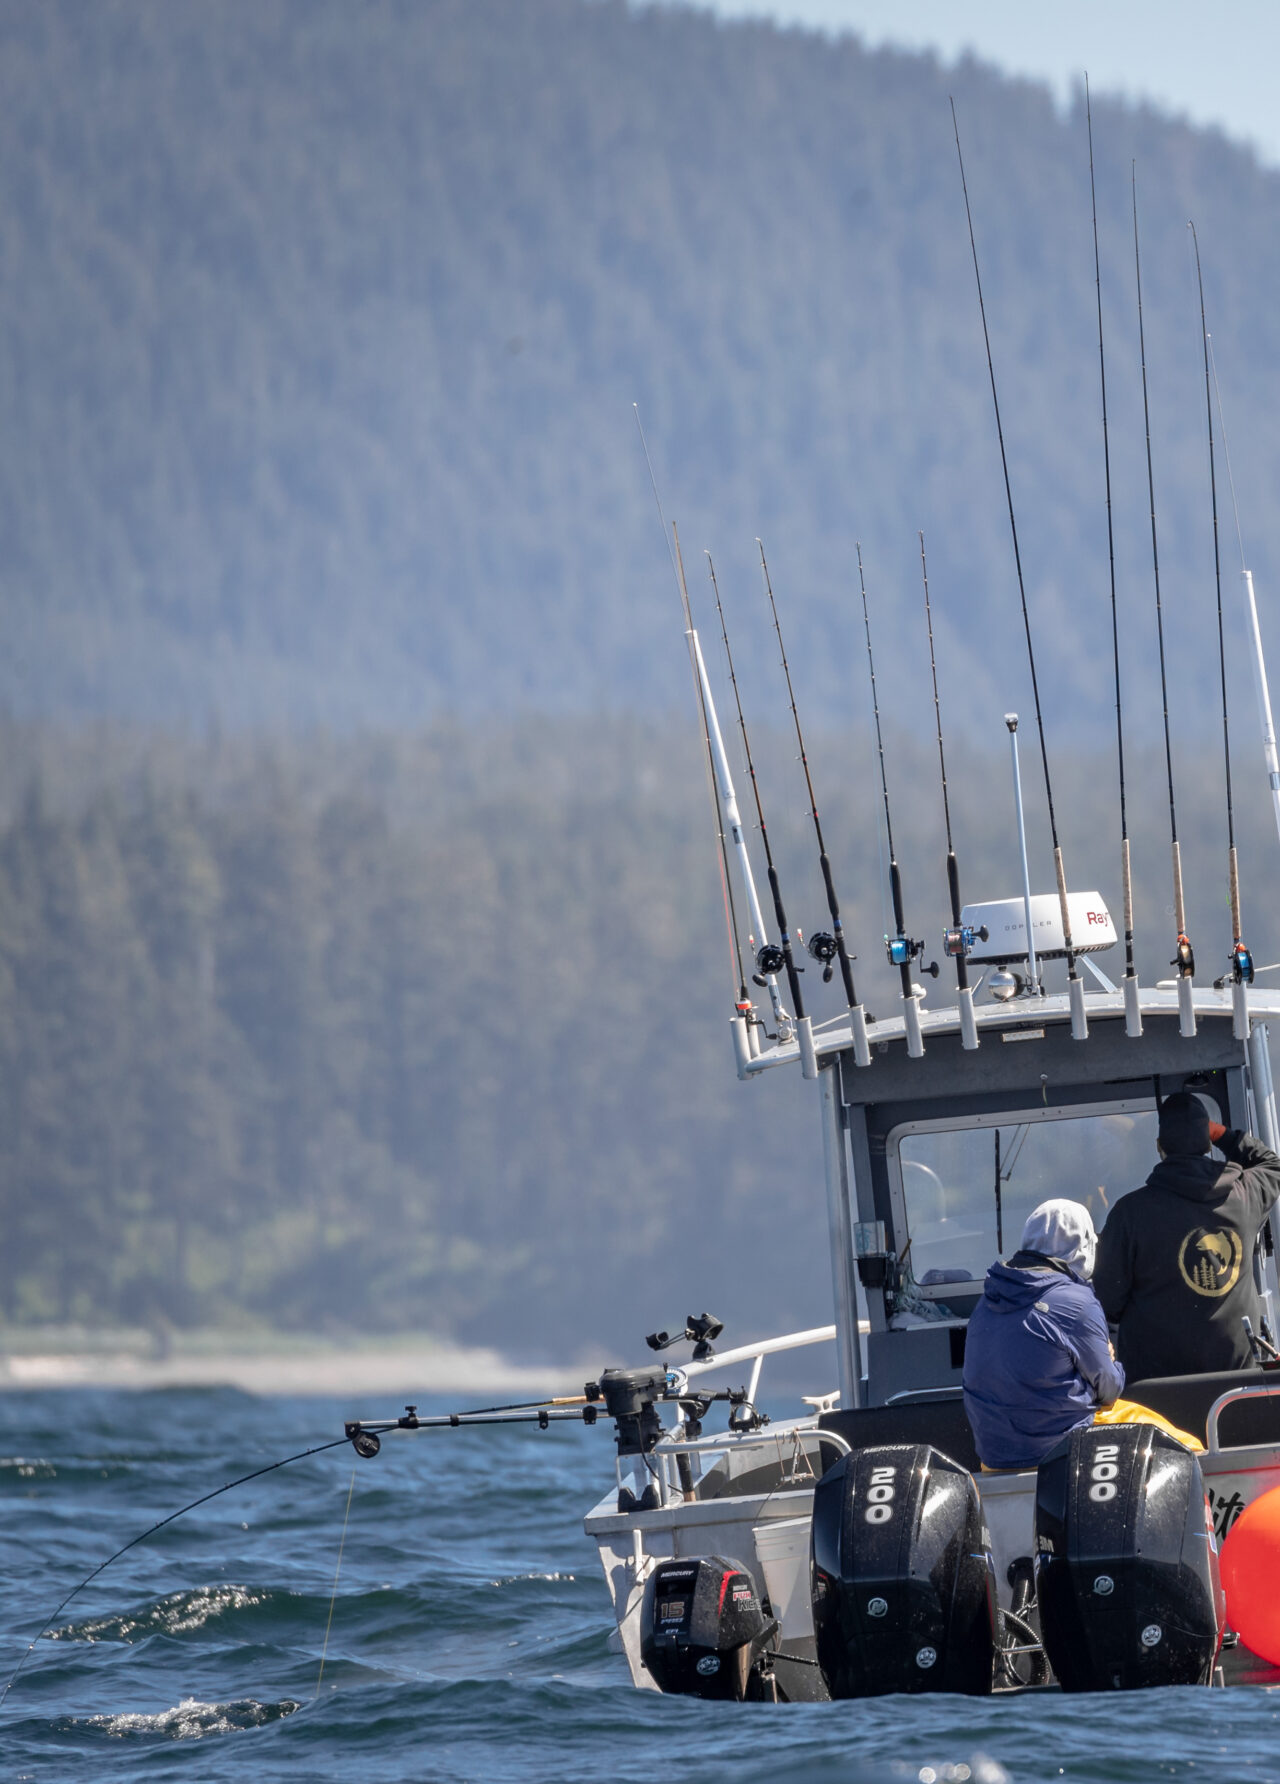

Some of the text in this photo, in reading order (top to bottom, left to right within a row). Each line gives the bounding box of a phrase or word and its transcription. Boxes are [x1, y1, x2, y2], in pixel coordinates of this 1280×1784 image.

[1005, 920, 1052, 931] DOPLER
[1086, 1424, 1137, 1433] MERCURY
[863, 1445, 915, 1454] MERCURY
[1089, 1445, 1119, 1502] 200
[865, 1466, 896, 1525] 200
[660, 1570, 694, 1578] MERCURY
[661, 1601, 685, 1618] 15
